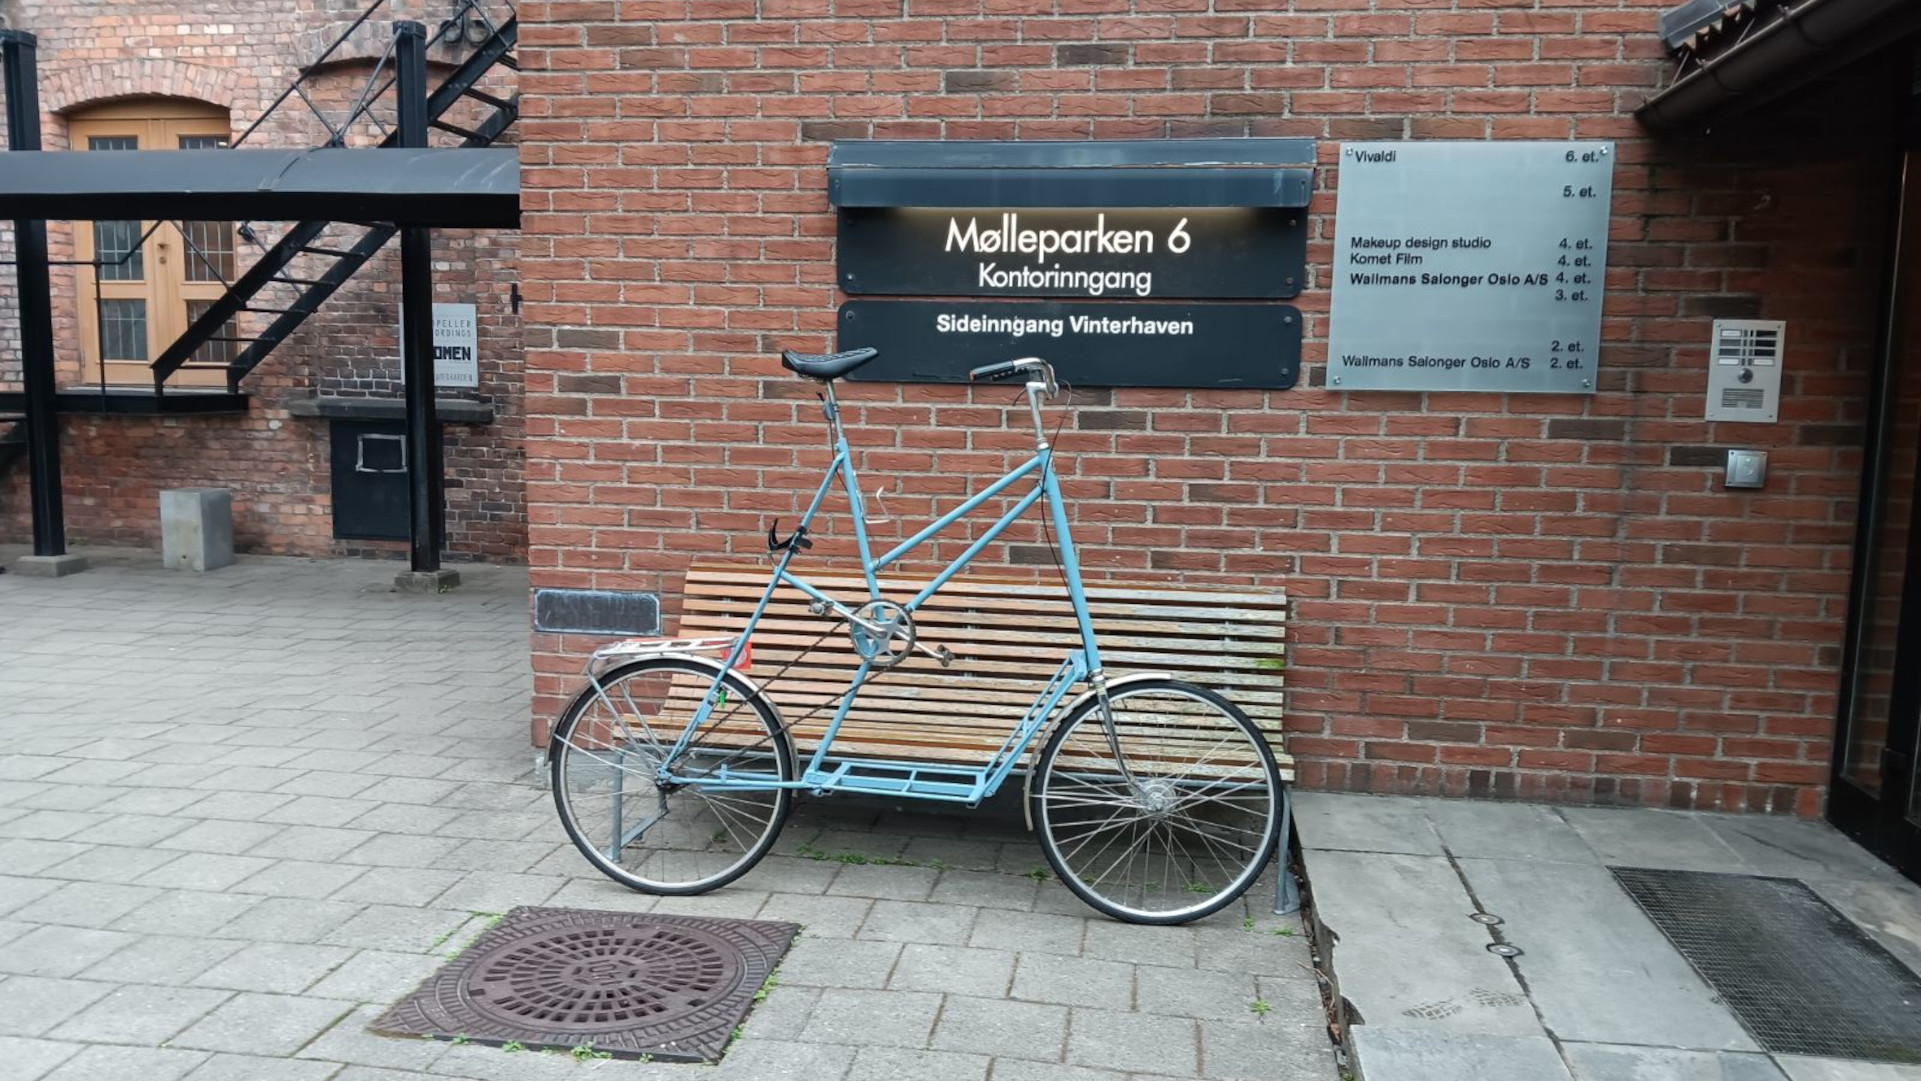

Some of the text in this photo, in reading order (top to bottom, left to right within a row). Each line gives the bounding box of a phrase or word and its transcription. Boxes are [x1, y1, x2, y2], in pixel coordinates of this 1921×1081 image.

[1355, 151, 1396, 162] Vivaldi
[1565, 151, 1599, 162] 6. et.
[1563, 186, 1596, 198] 5. et.
[945, 213, 1191, 263] Mølleparken 6
[1351, 237, 1491, 250] Makeup design studio
[1559, 238, 1593, 249] 4. et.
[1350, 253, 1423, 265] Komet Film
[1558, 255, 1591, 267] 4. et.
[978, 262, 1152, 296] Kontorinngang
[1350, 273, 1548, 287] Wallmans Salonger Oslo A/S
[1556, 272, 1591, 284] 4. et.
[1555, 289, 1588, 301] 3. et.
[433, 320, 471, 328] PELLER
[936, 314, 1194, 337] Sideinngang Vinterhaven
[435, 329, 471, 338] ORDINGS
[1551, 340, 1584, 352] 2. et.
[1342, 355, 1530, 369] Wallmans Salonger Oslo A/S
[1550, 357, 1583, 369] 2. et.
